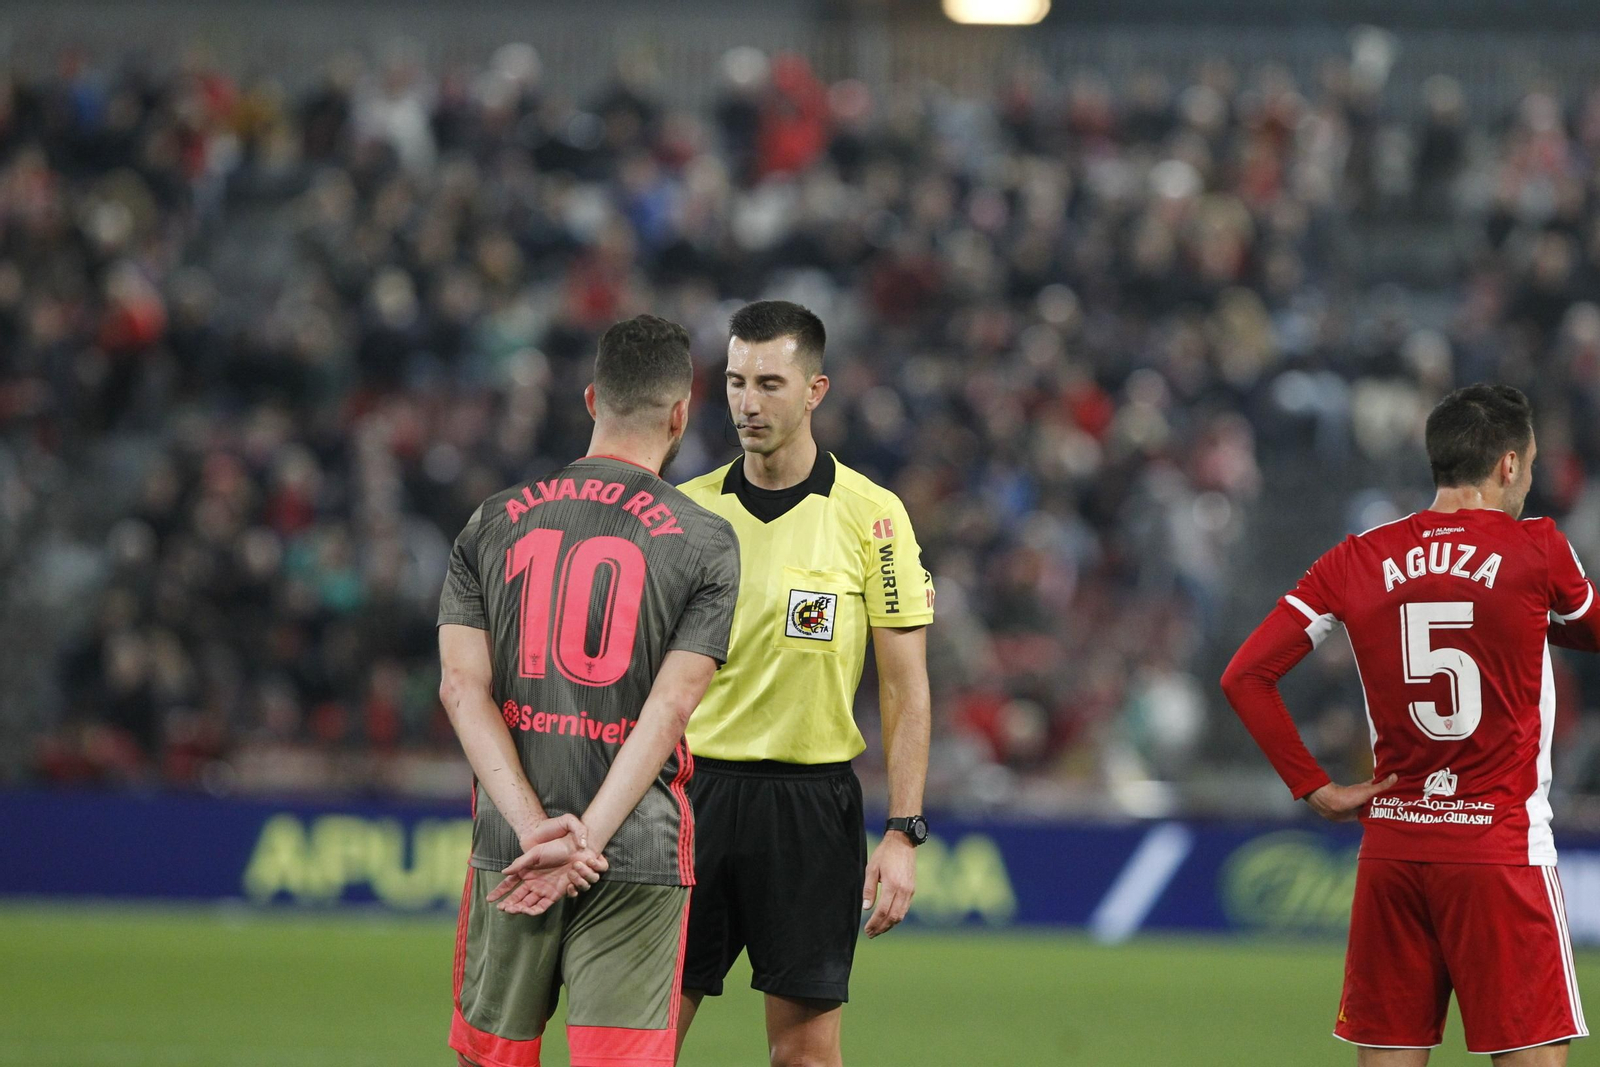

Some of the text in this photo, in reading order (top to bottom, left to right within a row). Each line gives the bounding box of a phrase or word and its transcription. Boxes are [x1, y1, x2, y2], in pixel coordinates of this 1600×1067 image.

[504, 478, 685, 538] ALVARO REY
[879, 543, 900, 614] WÜRTH
[1381, 541, 1503, 593] AGUZA
[504, 527, 647, 688] 10
[1399, 601, 1482, 742] 5
[1397, 806, 1433, 824] SAMAD
[1443, 811, 1493, 825] QURASHI
